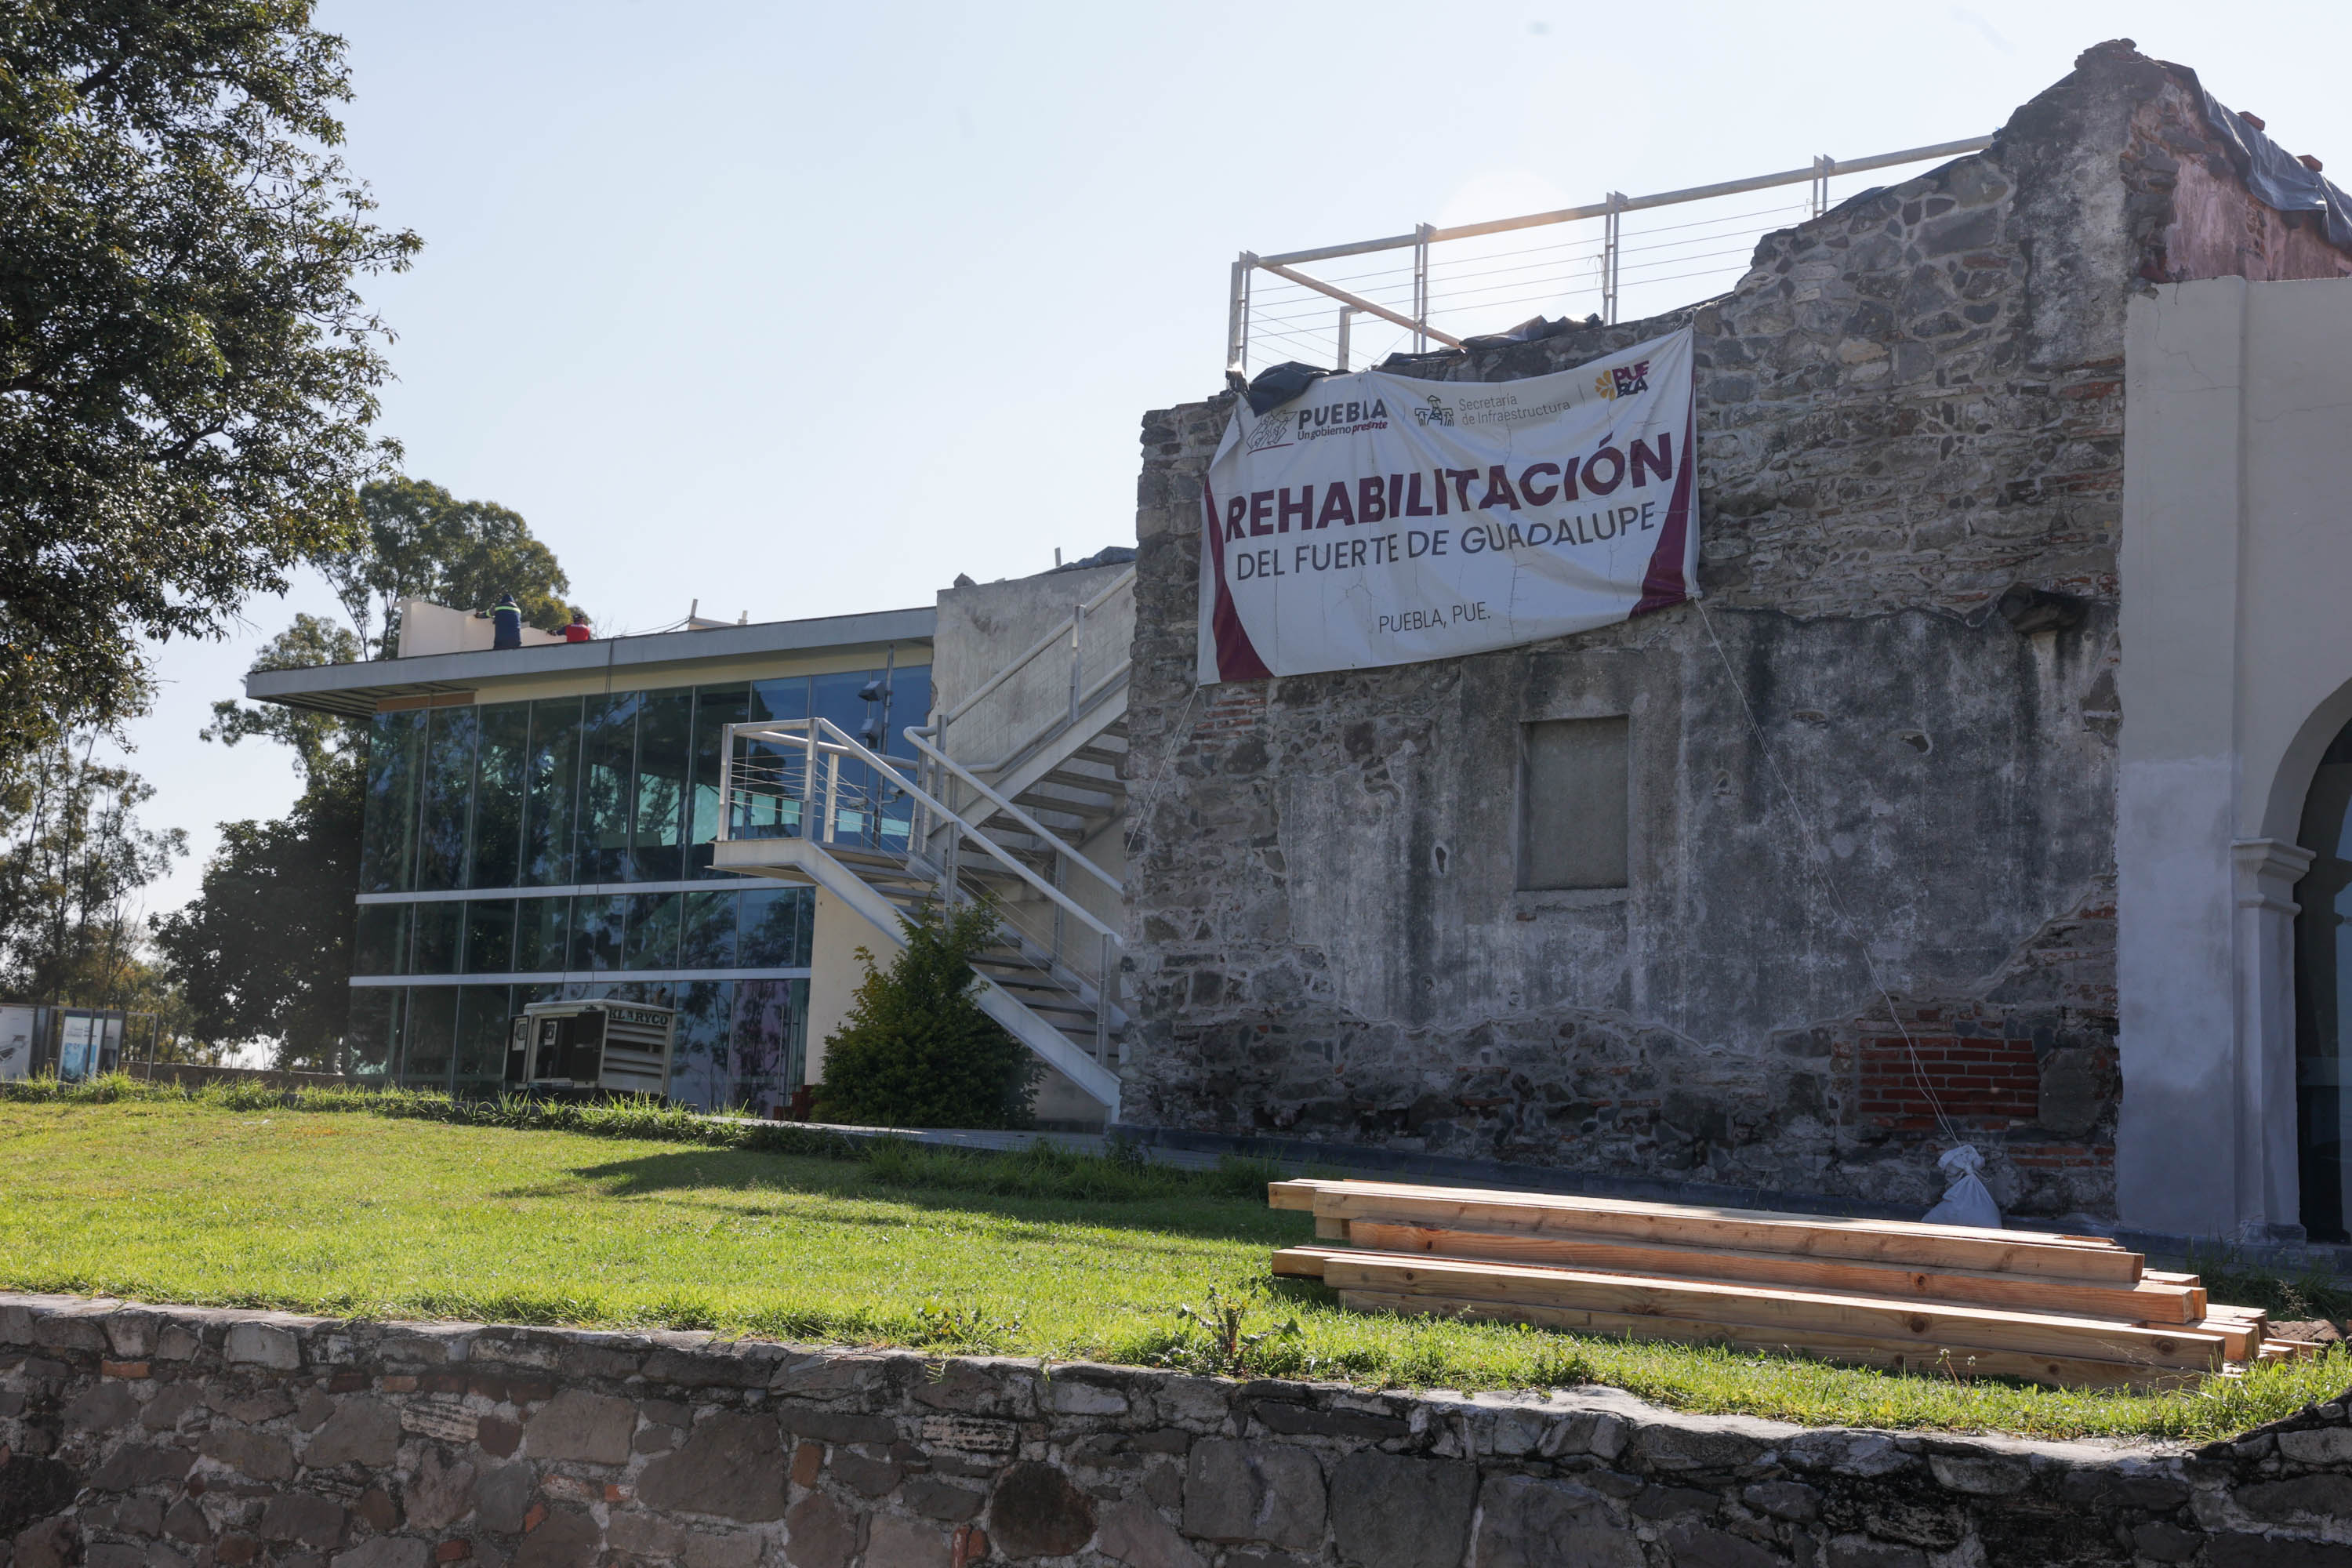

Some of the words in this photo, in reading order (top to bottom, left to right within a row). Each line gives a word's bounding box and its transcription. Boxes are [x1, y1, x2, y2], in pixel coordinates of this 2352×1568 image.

[1298, 398, 1388, 430] PUEBLA
[1458, 393, 1519, 412] Secretaría
[1461, 413, 1475, 426] de
[1478, 401, 1572, 425] Infraestructura
[1225, 432, 1673, 543] REHABILITACIÓN
[1237, 550, 1285, 580] DEL
[1295, 533, 1399, 574] FUERTE
[1408, 529, 1450, 559] DE
[1461, 501, 1656, 554] GUADALUPE
[1379, 608, 1446, 634] PUEBLA,
[1452, 601, 1491, 624] PUE.
